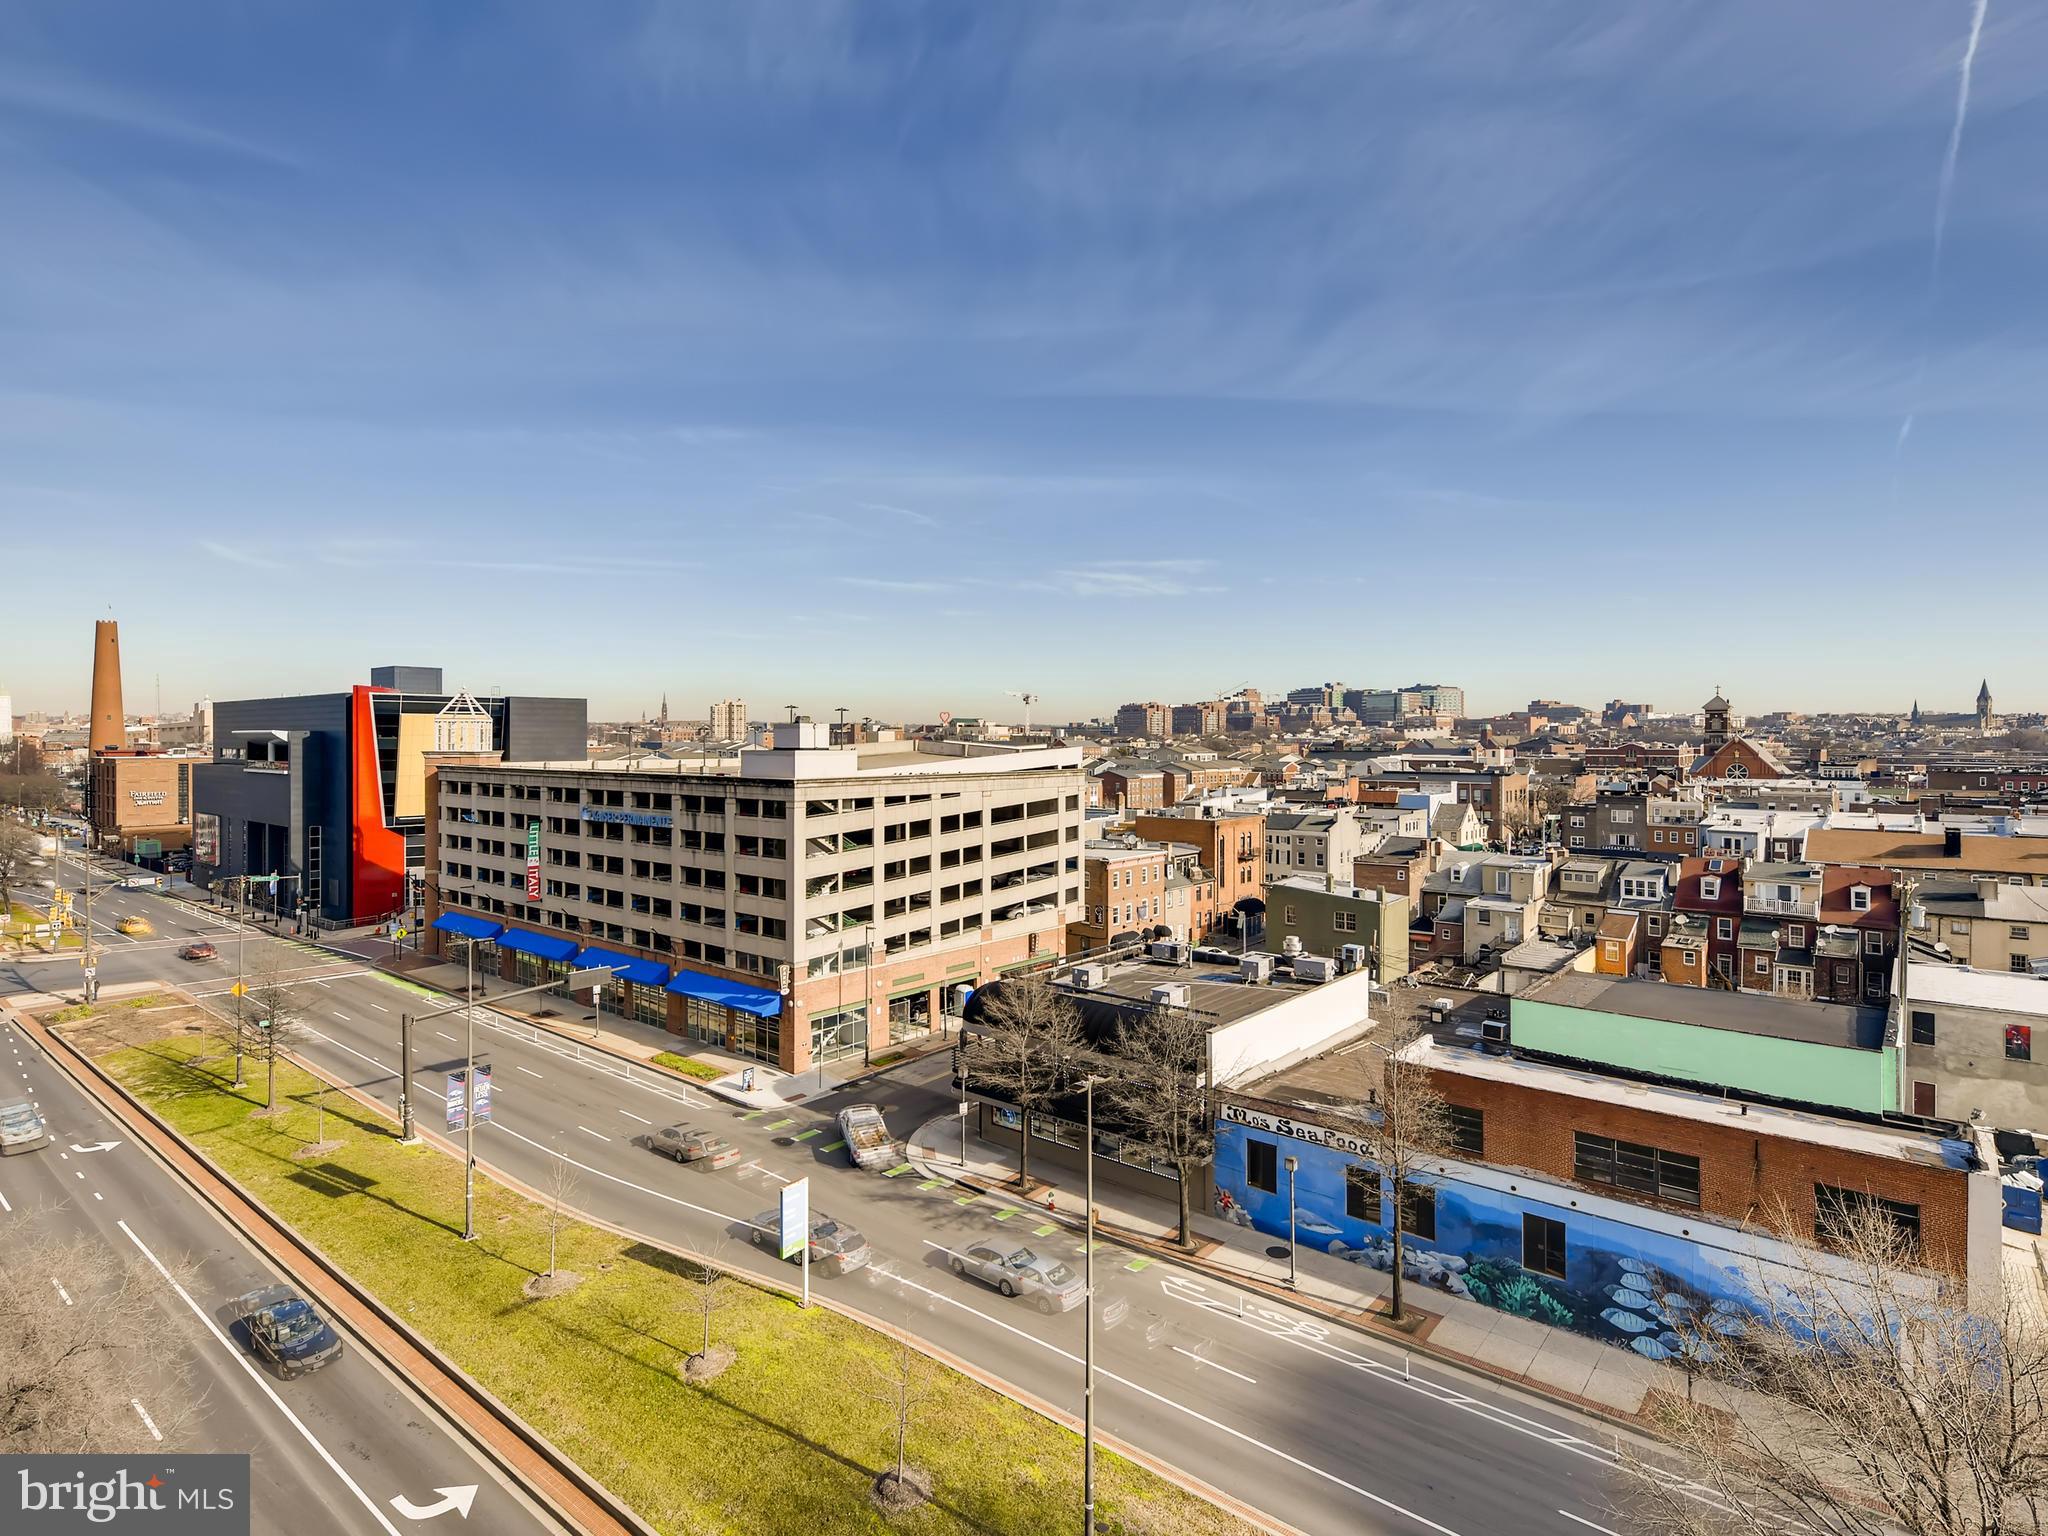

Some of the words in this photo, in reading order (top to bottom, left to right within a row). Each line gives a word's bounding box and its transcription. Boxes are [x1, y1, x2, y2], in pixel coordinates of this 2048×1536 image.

[591, 809, 617, 823] KAISER
[619, 811, 673, 828] PERMANENTE
[529, 823, 540, 857] LITTLE
[528, 868, 539, 898] ITALY
[1226, 1105, 1271, 1130] Mo's
